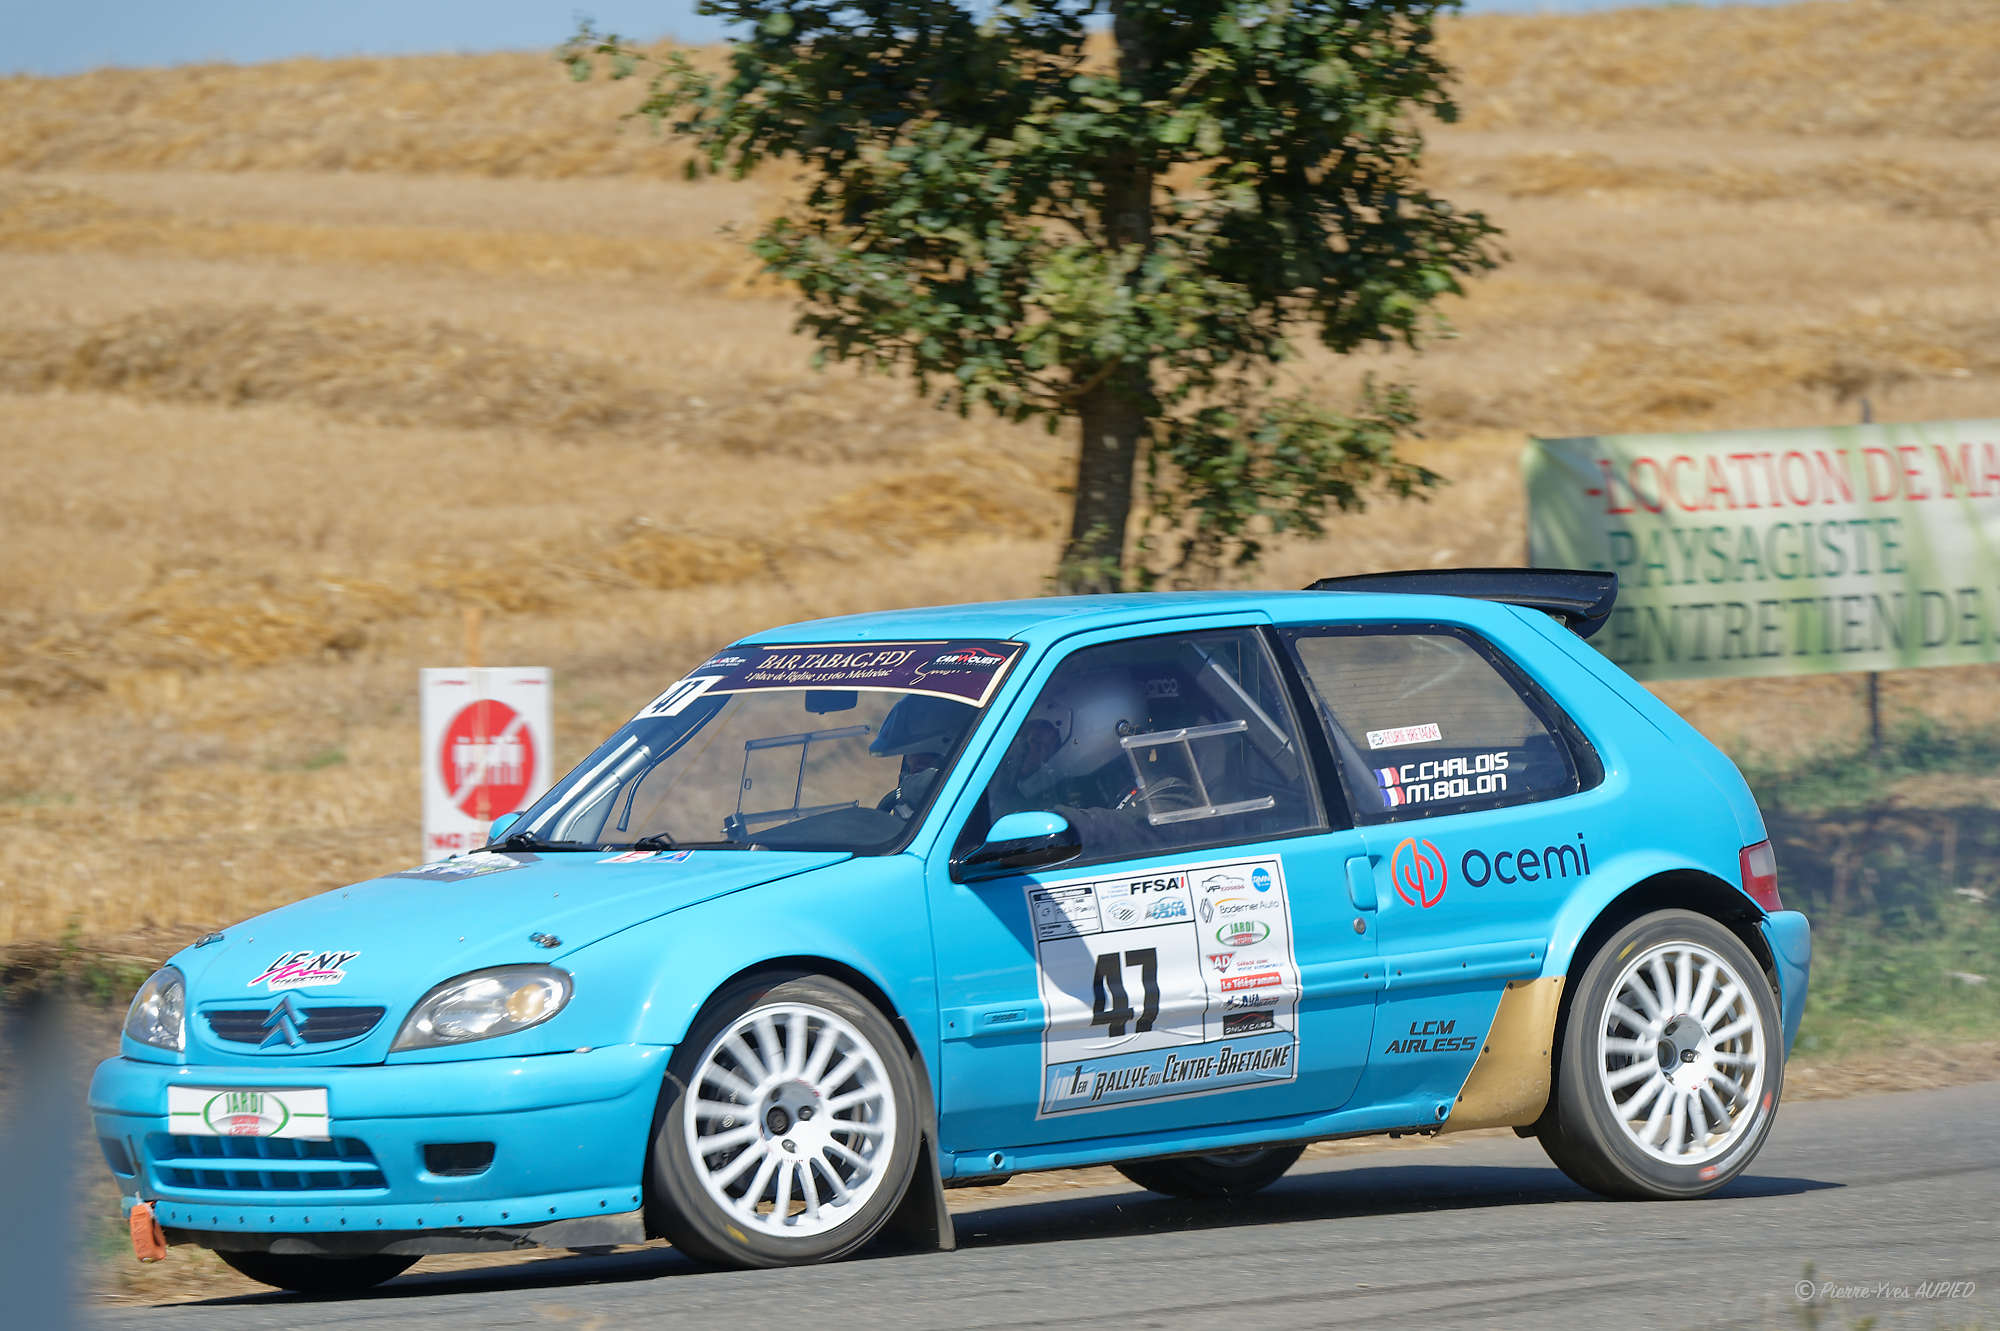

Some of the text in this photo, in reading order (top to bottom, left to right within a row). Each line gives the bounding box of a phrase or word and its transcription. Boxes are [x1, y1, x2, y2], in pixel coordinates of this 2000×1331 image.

[1862, 446, 1927, 502] DE
[1918, 587, 1982, 650] DE
[1400, 752, 1508, 783] C.CHALOIS
[1406, 773, 1507, 804] M.BOLON
[1461, 832, 1591, 888] Ocemi
[1130, 877, 1180, 895] FFSA
[1230, 920, 1255, 934] JARDI
[1214, 955, 1231, 969] AD
[1091, 948, 1160, 1038] 47
[1409, 1019, 1456, 1036] LCM
[1384, 1036, 1477, 1055] AIRLESS
[1091, 1066, 1150, 1101] RALLYE
[1161, 1045, 1291, 1083] CENTRE-BRETAGNE
[225, 1092, 265, 1114] JARDI
